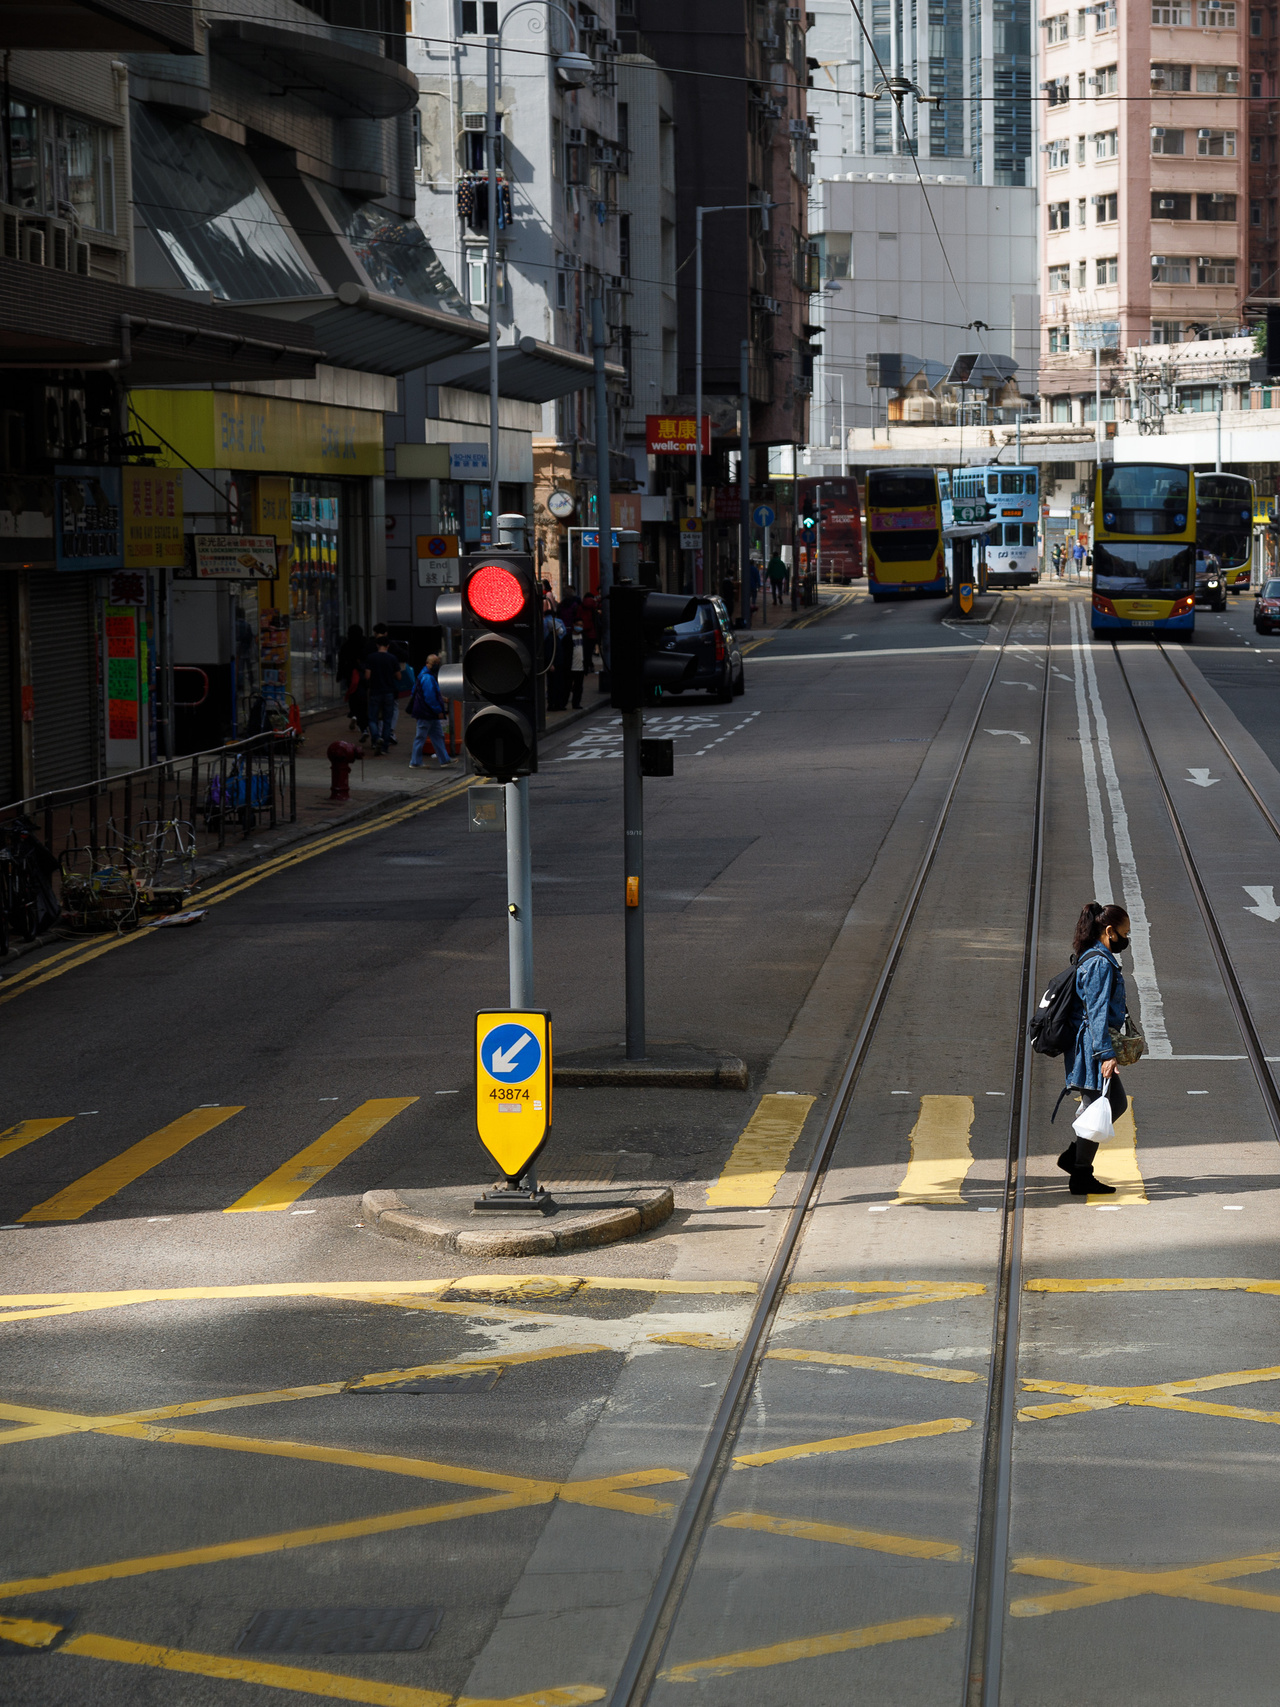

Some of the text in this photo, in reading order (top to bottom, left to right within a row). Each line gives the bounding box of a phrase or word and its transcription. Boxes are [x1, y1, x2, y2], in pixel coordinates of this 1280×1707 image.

[658, 419, 697, 439] 惠康
[430, 561, 448, 569] End
[426, 572, 453, 584] 終止
[489, 1088, 530, 1100] 43874
